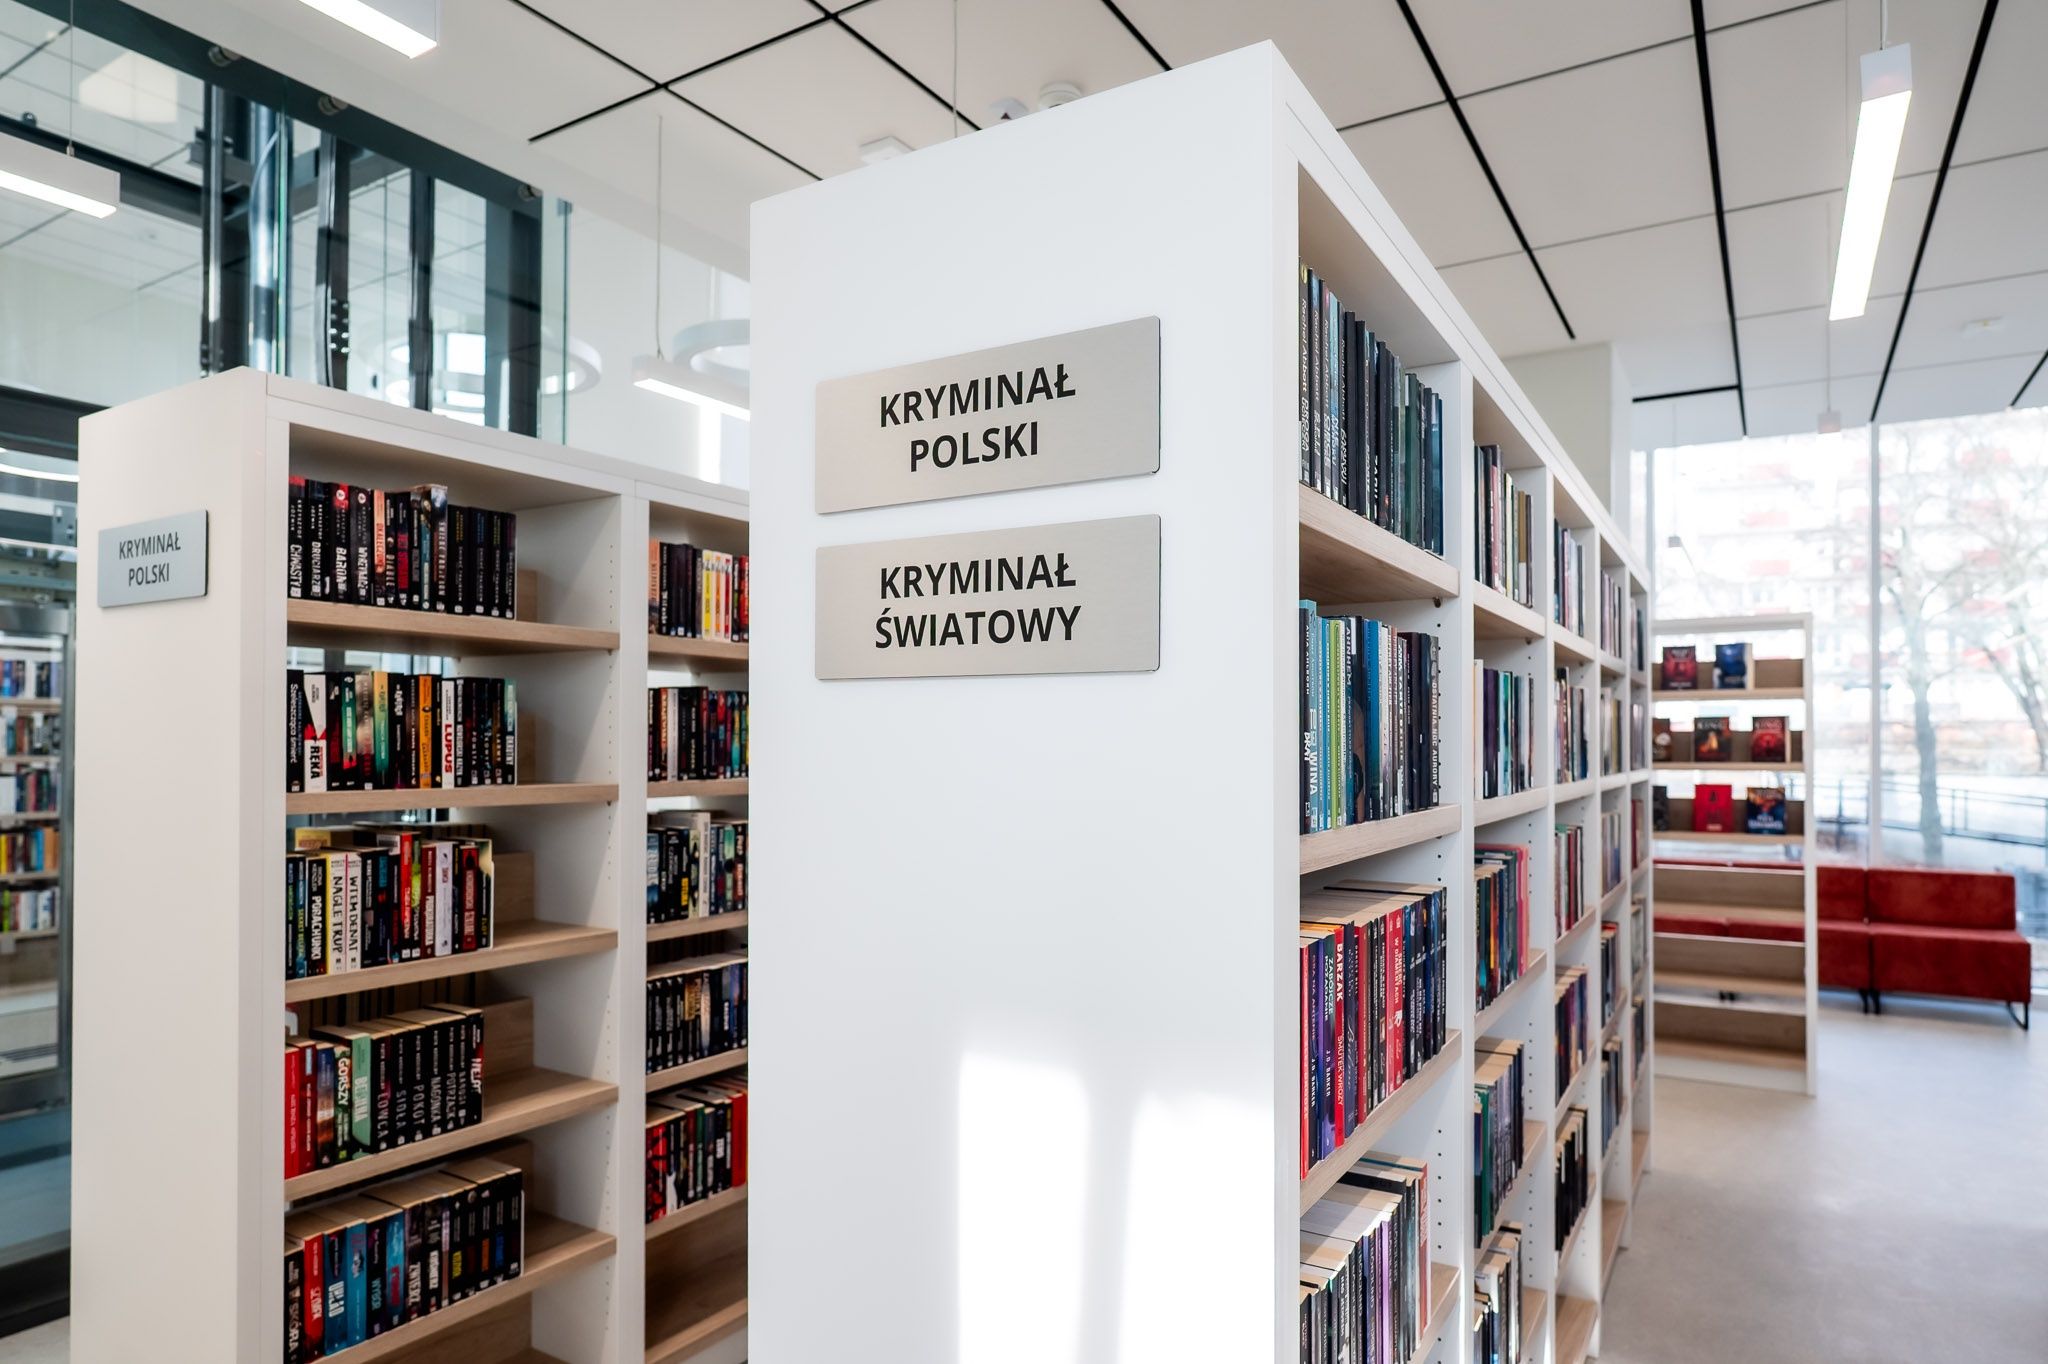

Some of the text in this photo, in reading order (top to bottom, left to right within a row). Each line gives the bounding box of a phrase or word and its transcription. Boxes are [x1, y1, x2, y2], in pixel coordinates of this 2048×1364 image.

[880, 363, 1077, 428] KRYMINAŁ
[910, 421, 1039, 472] POLSKI
[119, 532, 182, 560] KRYMINAŁ
[290, 544, 303, 587] CHWASTY
[336, 547, 348, 584] BARON
[128, 562, 170, 587] POLSKI
[880, 552, 1077, 599] KRYMINAŁ
[874, 605, 1082, 649] ŚWIATOWY
[309, 744, 321, 779] RĘKA
[444, 723, 453, 774] LUPUS
[1310, 751, 1318, 795] WINA
[332, 876, 344, 954] NAGLE TRUP
[349, 876, 359, 952] WTEM DENAT
[338, 1057, 349, 1105] GORSZY
[377, 1092, 390, 1139] ŁOWCA
[395, 1089, 407, 1129] SIDŁA
[412, 1084, 425, 1125] POKOT
